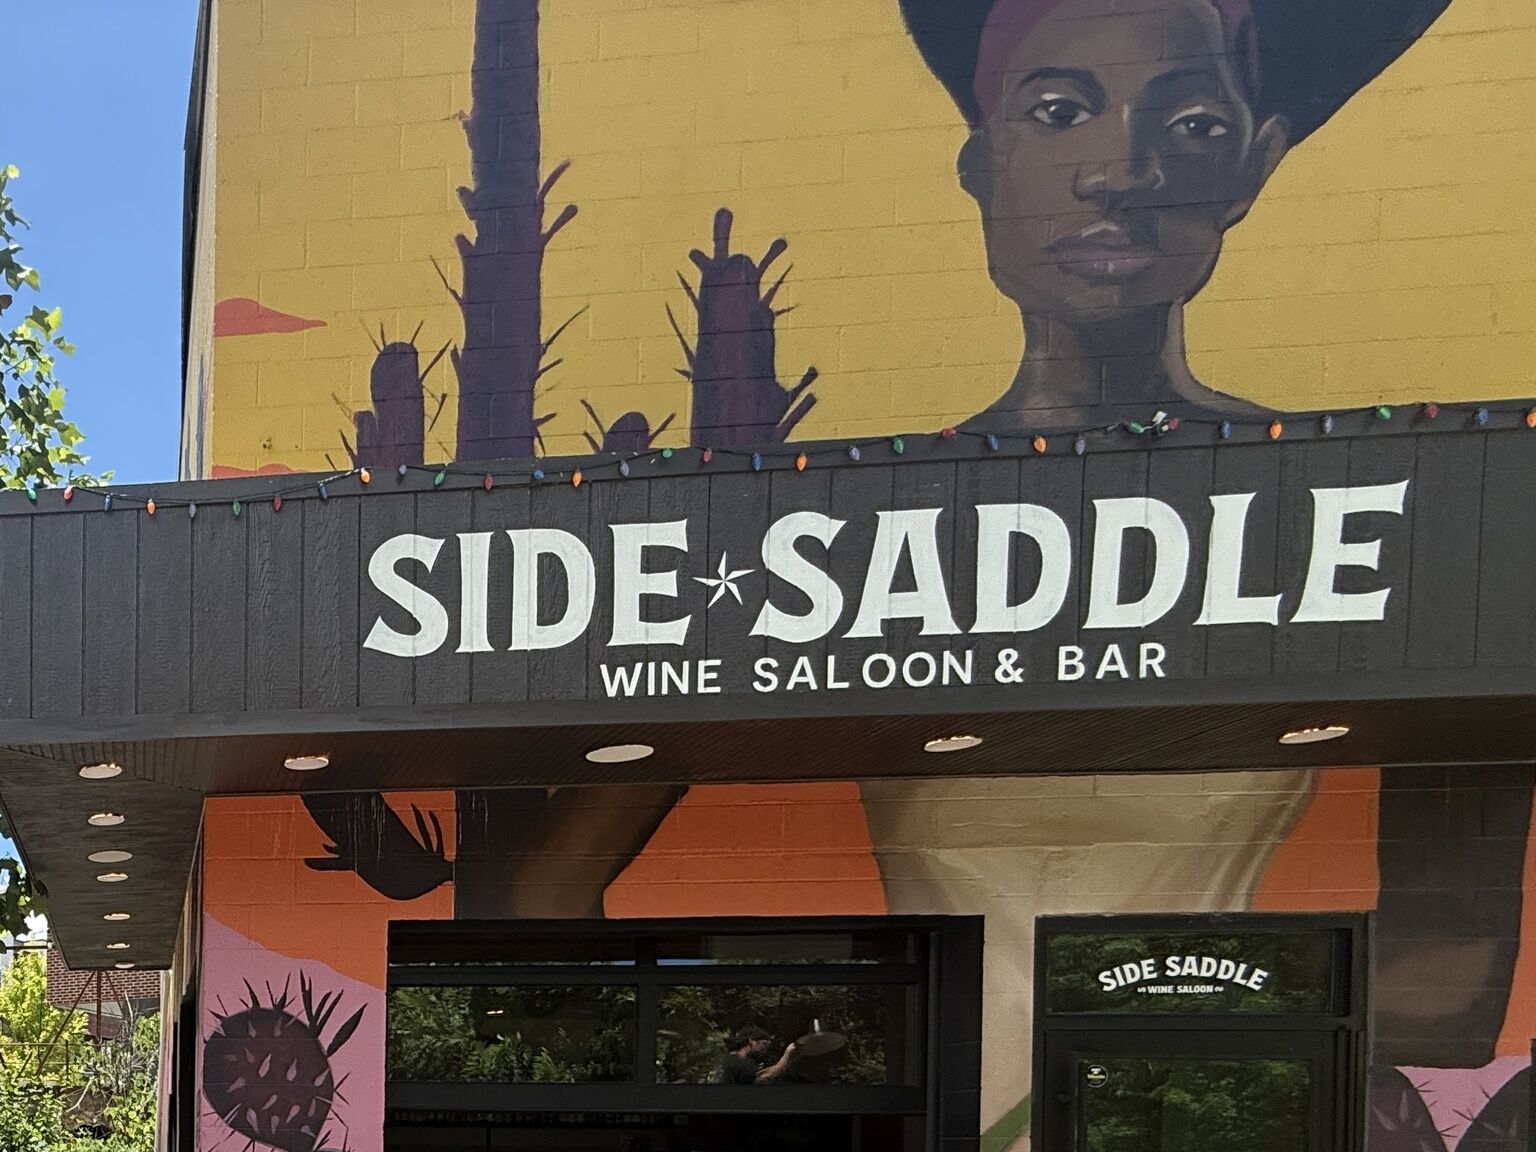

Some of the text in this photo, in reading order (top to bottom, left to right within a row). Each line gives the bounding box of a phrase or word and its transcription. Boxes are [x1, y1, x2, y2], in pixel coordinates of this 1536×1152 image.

[362, 478, 1411, 657] SIDE SADDLE
[600, 641, 1166, 698] WINE SALOON & BAR
[1098, 955, 1269, 992] SIDE SADDLE
[1147, 984, 1214, 994] WINE SALOON
